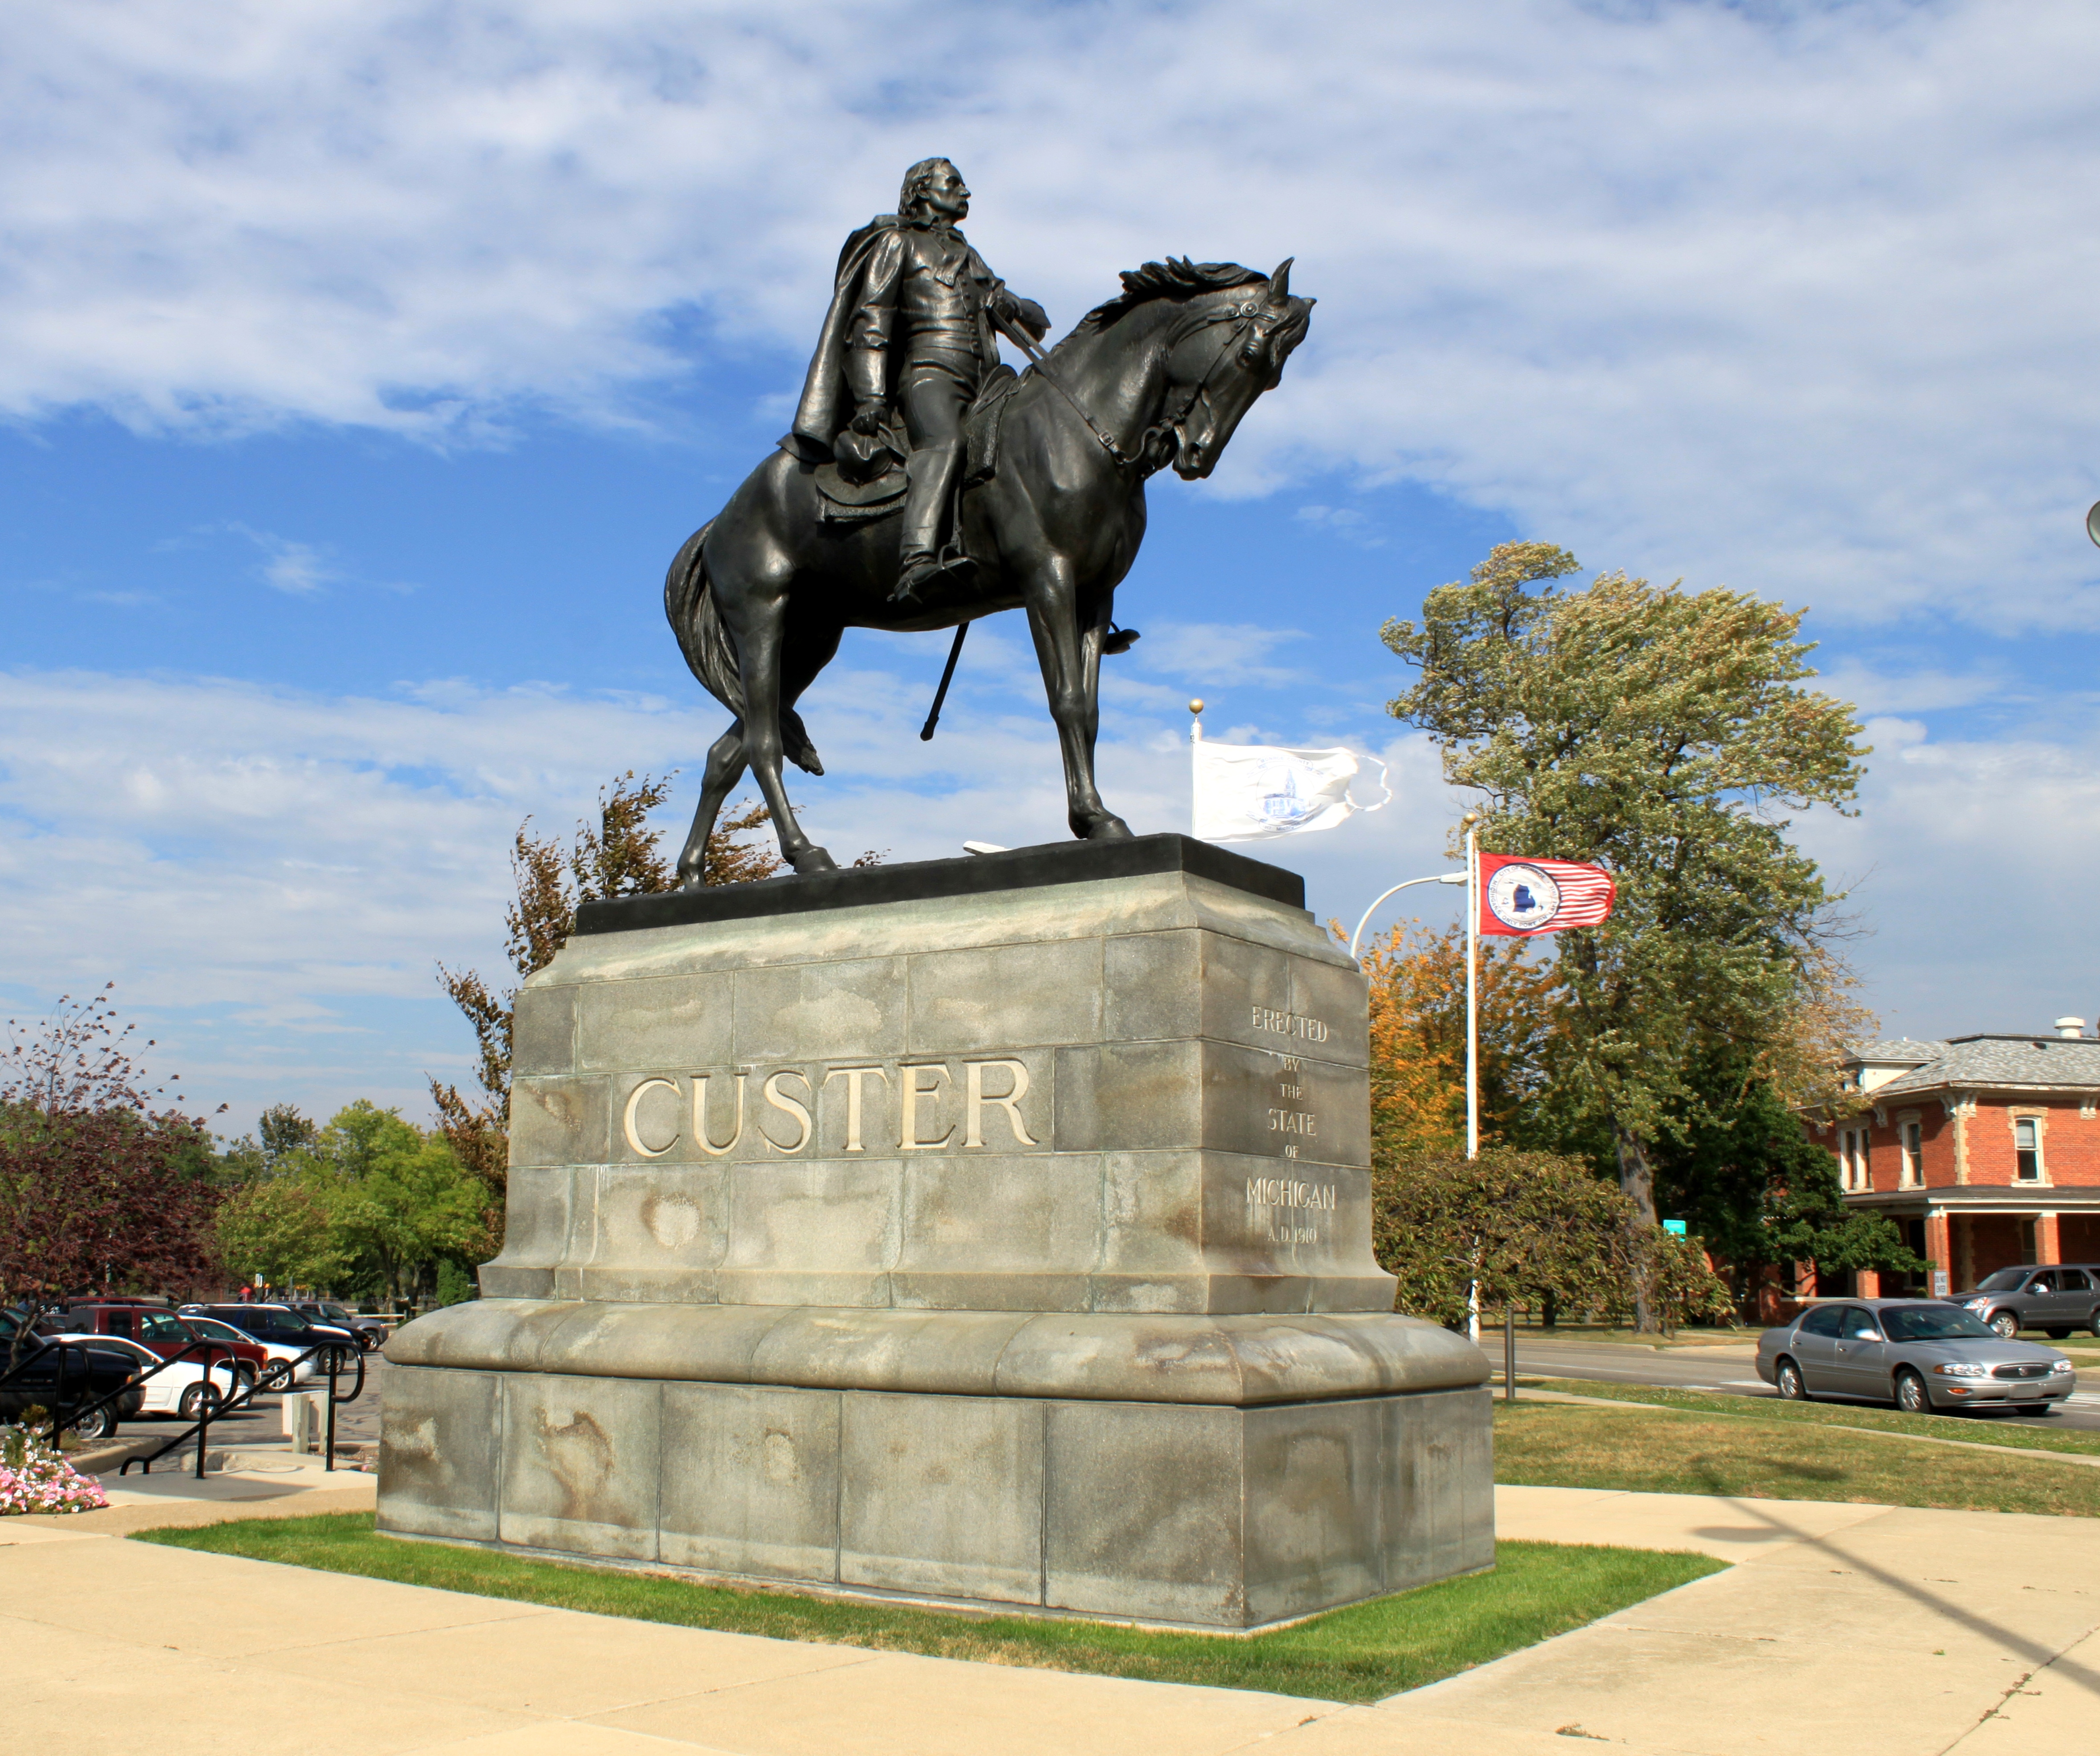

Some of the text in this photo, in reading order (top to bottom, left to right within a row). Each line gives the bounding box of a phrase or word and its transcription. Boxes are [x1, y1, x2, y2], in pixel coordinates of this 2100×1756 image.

[1287, 757, 1310, 765] COUNTY
[1499, 868, 1511, 876] CITY
[1502, 915, 1518, 926] ONLY
[1252, 1006, 1327, 1042] ERECTED
[1283, 1057, 1300, 1072] BY
[1279, 1083, 1303, 1101] THE
[623, 1057, 1040, 1158] CUSTER
[1267, 1108, 1316, 1136] STATE
[1285, 1144, 1299, 1159] OF
[1246, 1176, 1335, 1211] MICHIGAN
[1295, 1227, 1317, 1244] 1910
